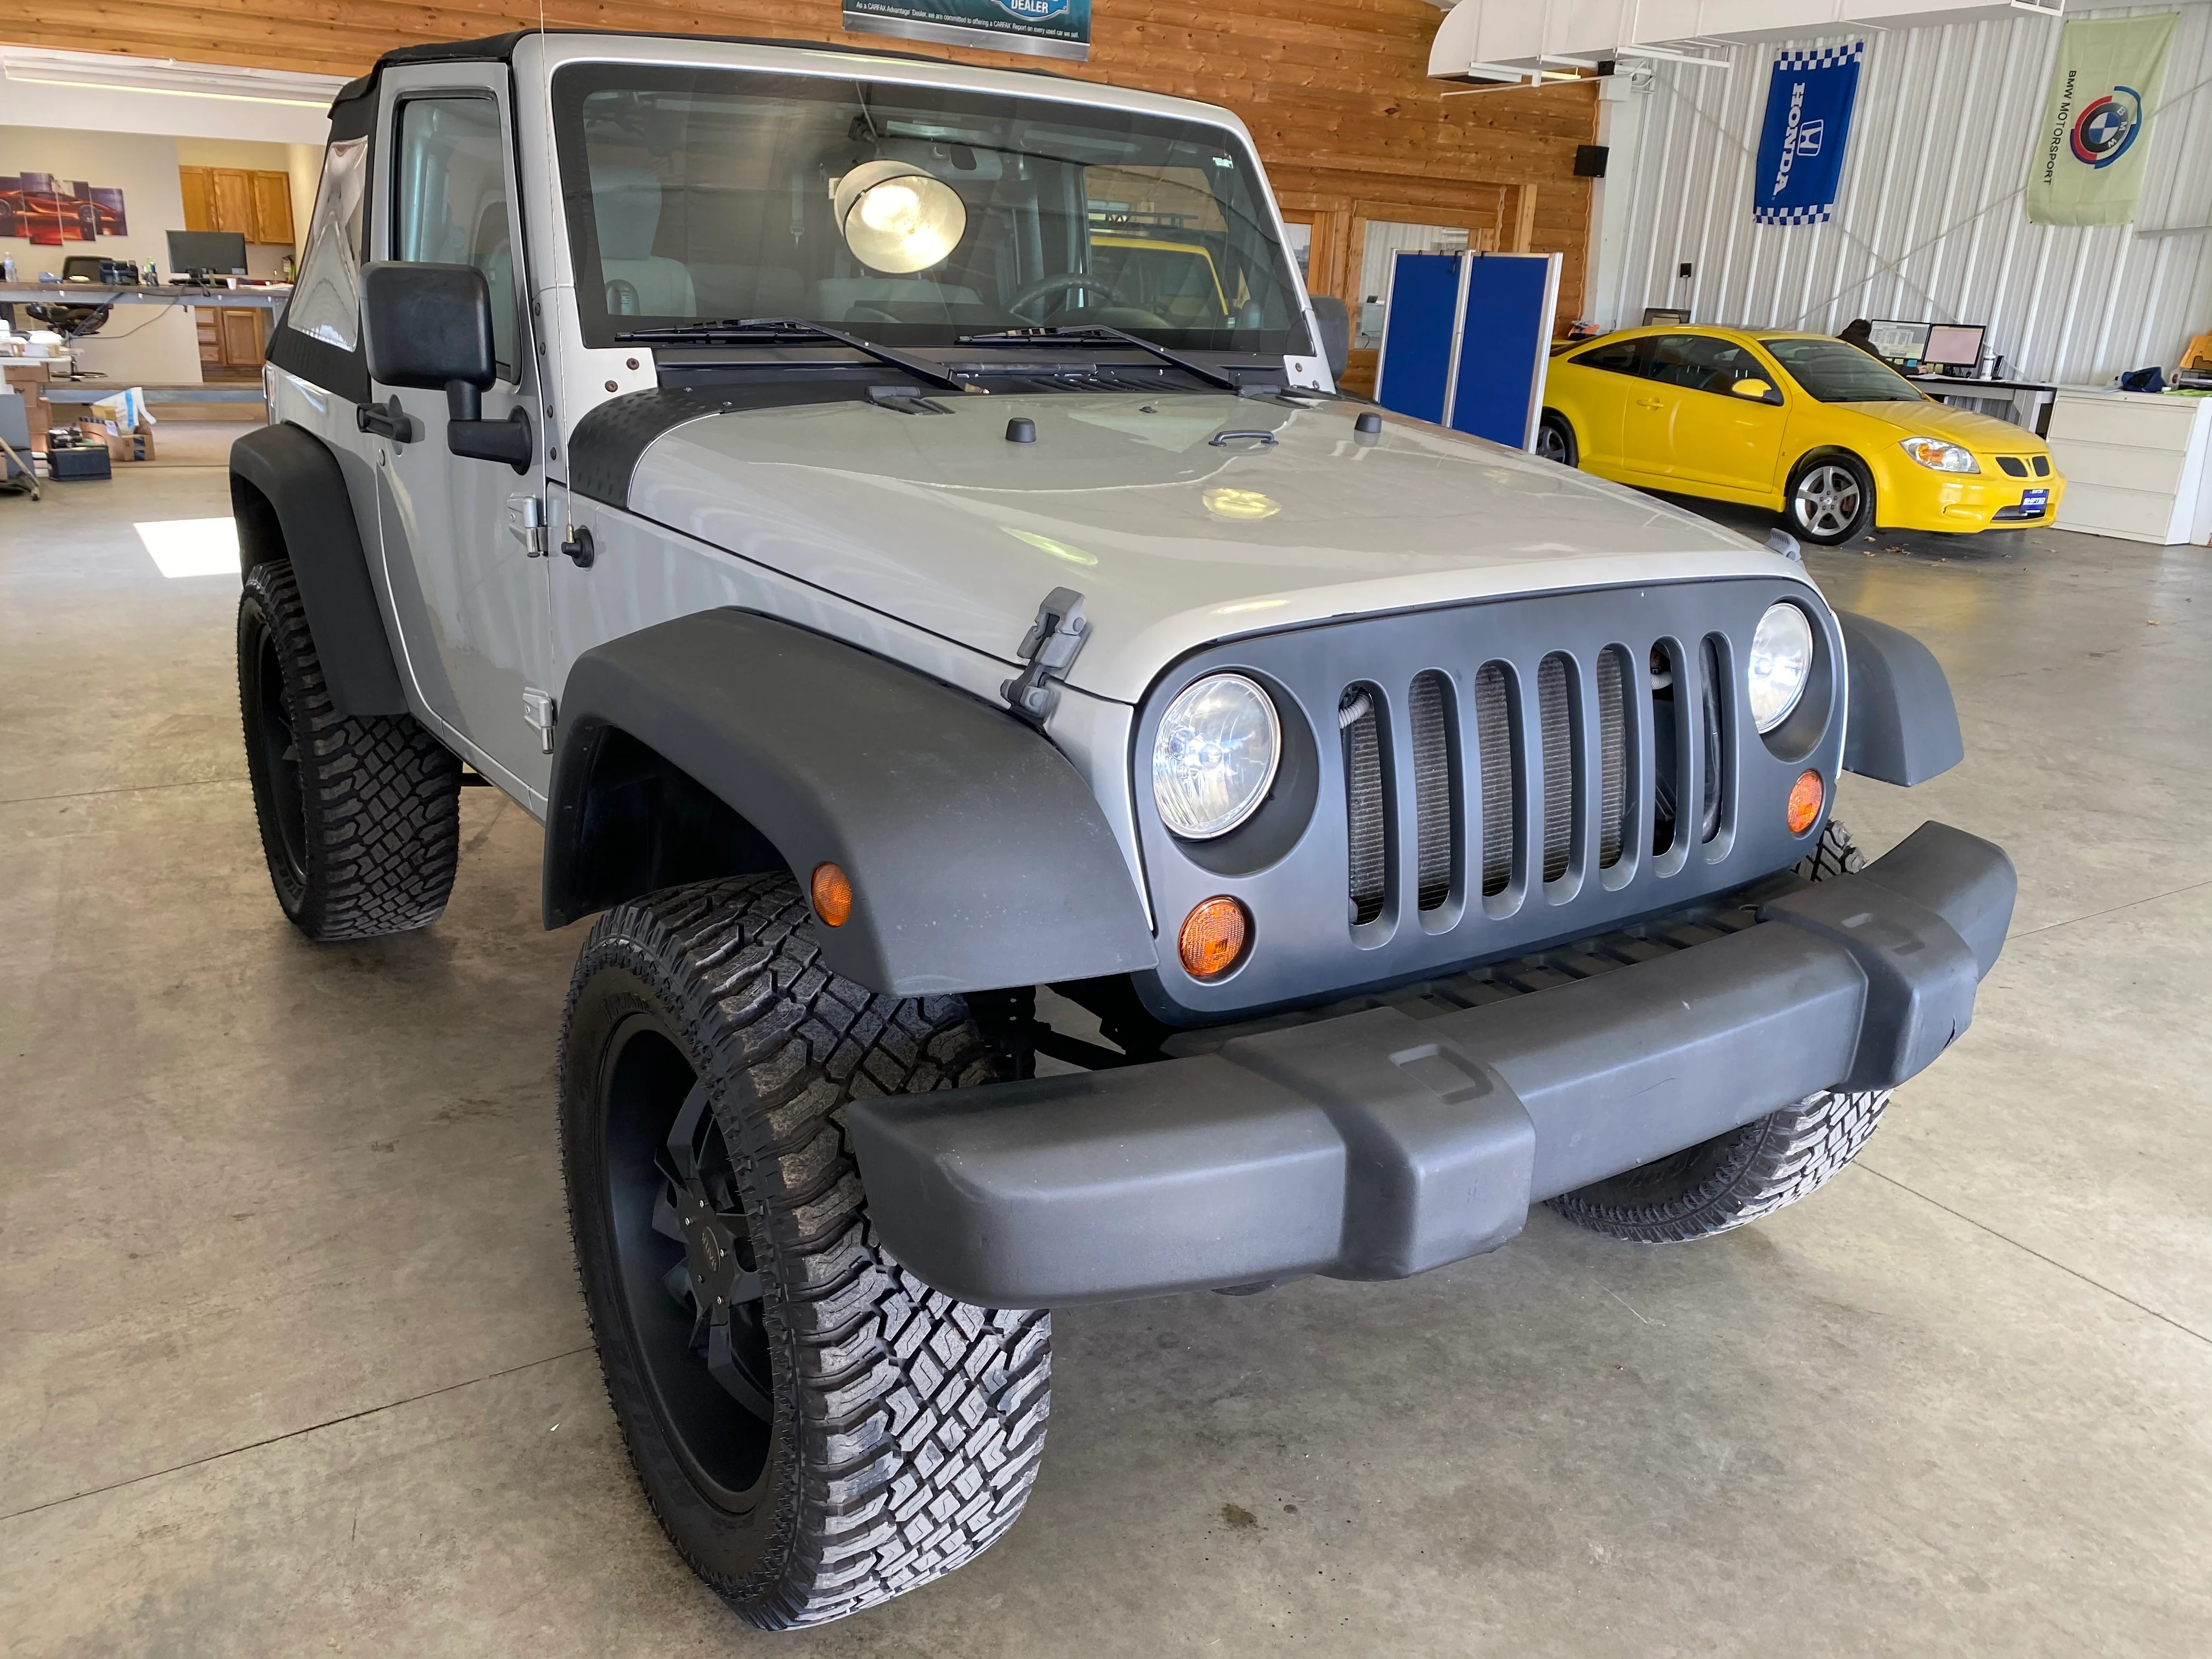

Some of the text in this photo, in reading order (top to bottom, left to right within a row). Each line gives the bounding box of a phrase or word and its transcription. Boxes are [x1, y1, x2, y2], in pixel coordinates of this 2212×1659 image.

[867, 3, 886, 11] CARFAX
[887, 5, 910, 16] Advantage
[912, 9, 928, 18] Dealer,
[944, 15, 967, 23] committed
[972, 18, 989, 27] offering
[1012, 22, 1026, 31] Report
[1011, 0, 1048, 14] DEALER
[1773, 83, 1805, 195] HONDA
[2044, 70, 2077, 185] BMW MOTORSPORT
[2108, 107, 2128, 148] BMW
